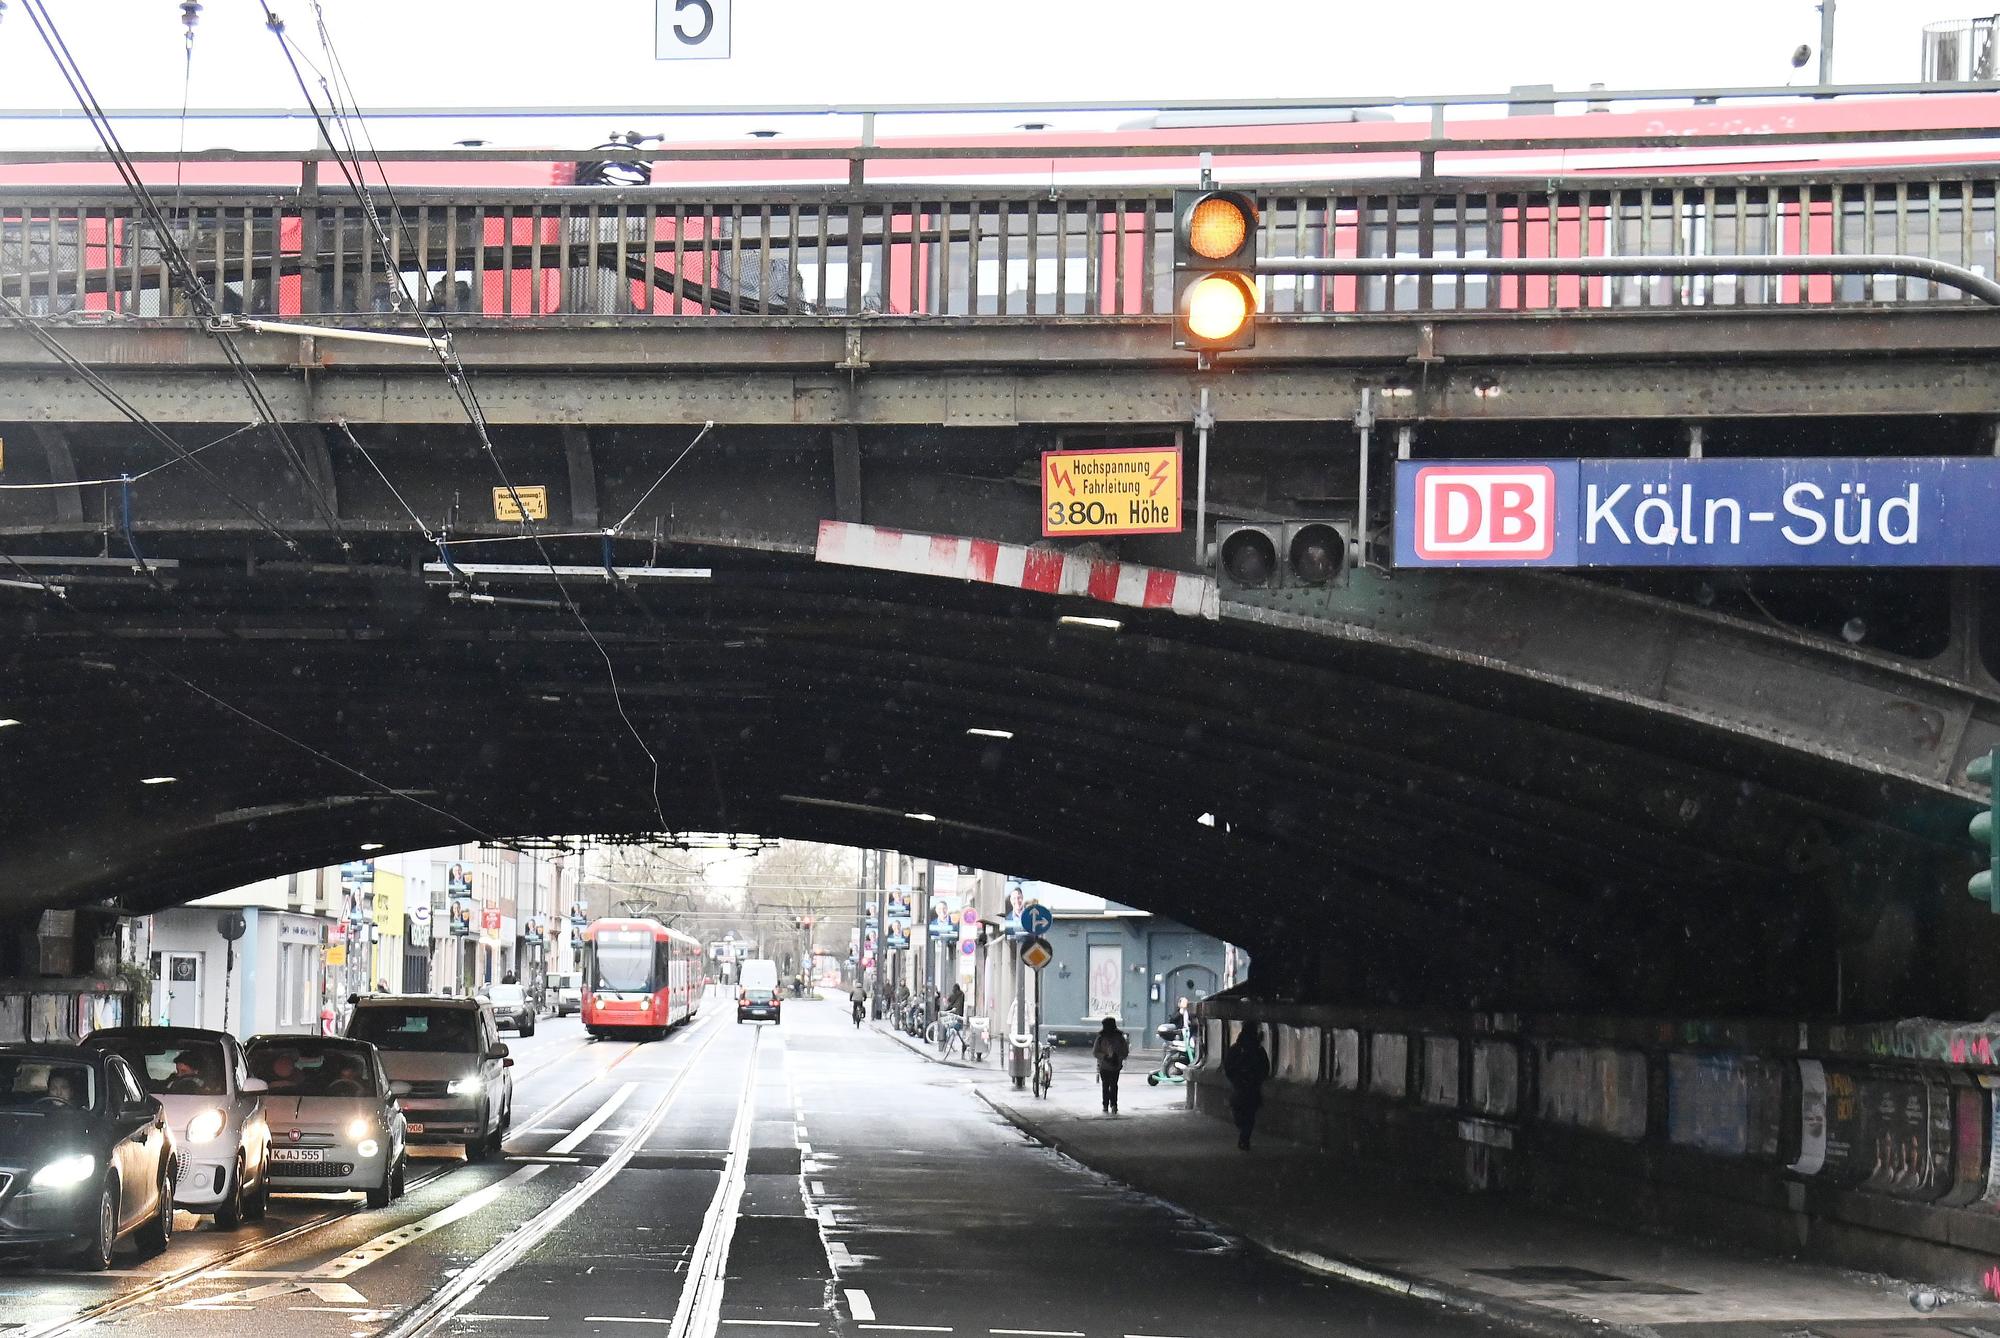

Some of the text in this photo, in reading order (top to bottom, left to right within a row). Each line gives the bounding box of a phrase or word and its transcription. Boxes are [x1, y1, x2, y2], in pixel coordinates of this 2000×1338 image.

[1073, 458, 1150, 477] Hochspannung
[1083, 478, 1140, 497] Fahrleitung
[1130, 499, 1169, 524] Höhe
[1435, 482, 1919, 545] DB Köln-Süd
[273, 1150, 319, 1160] K AJ 555
